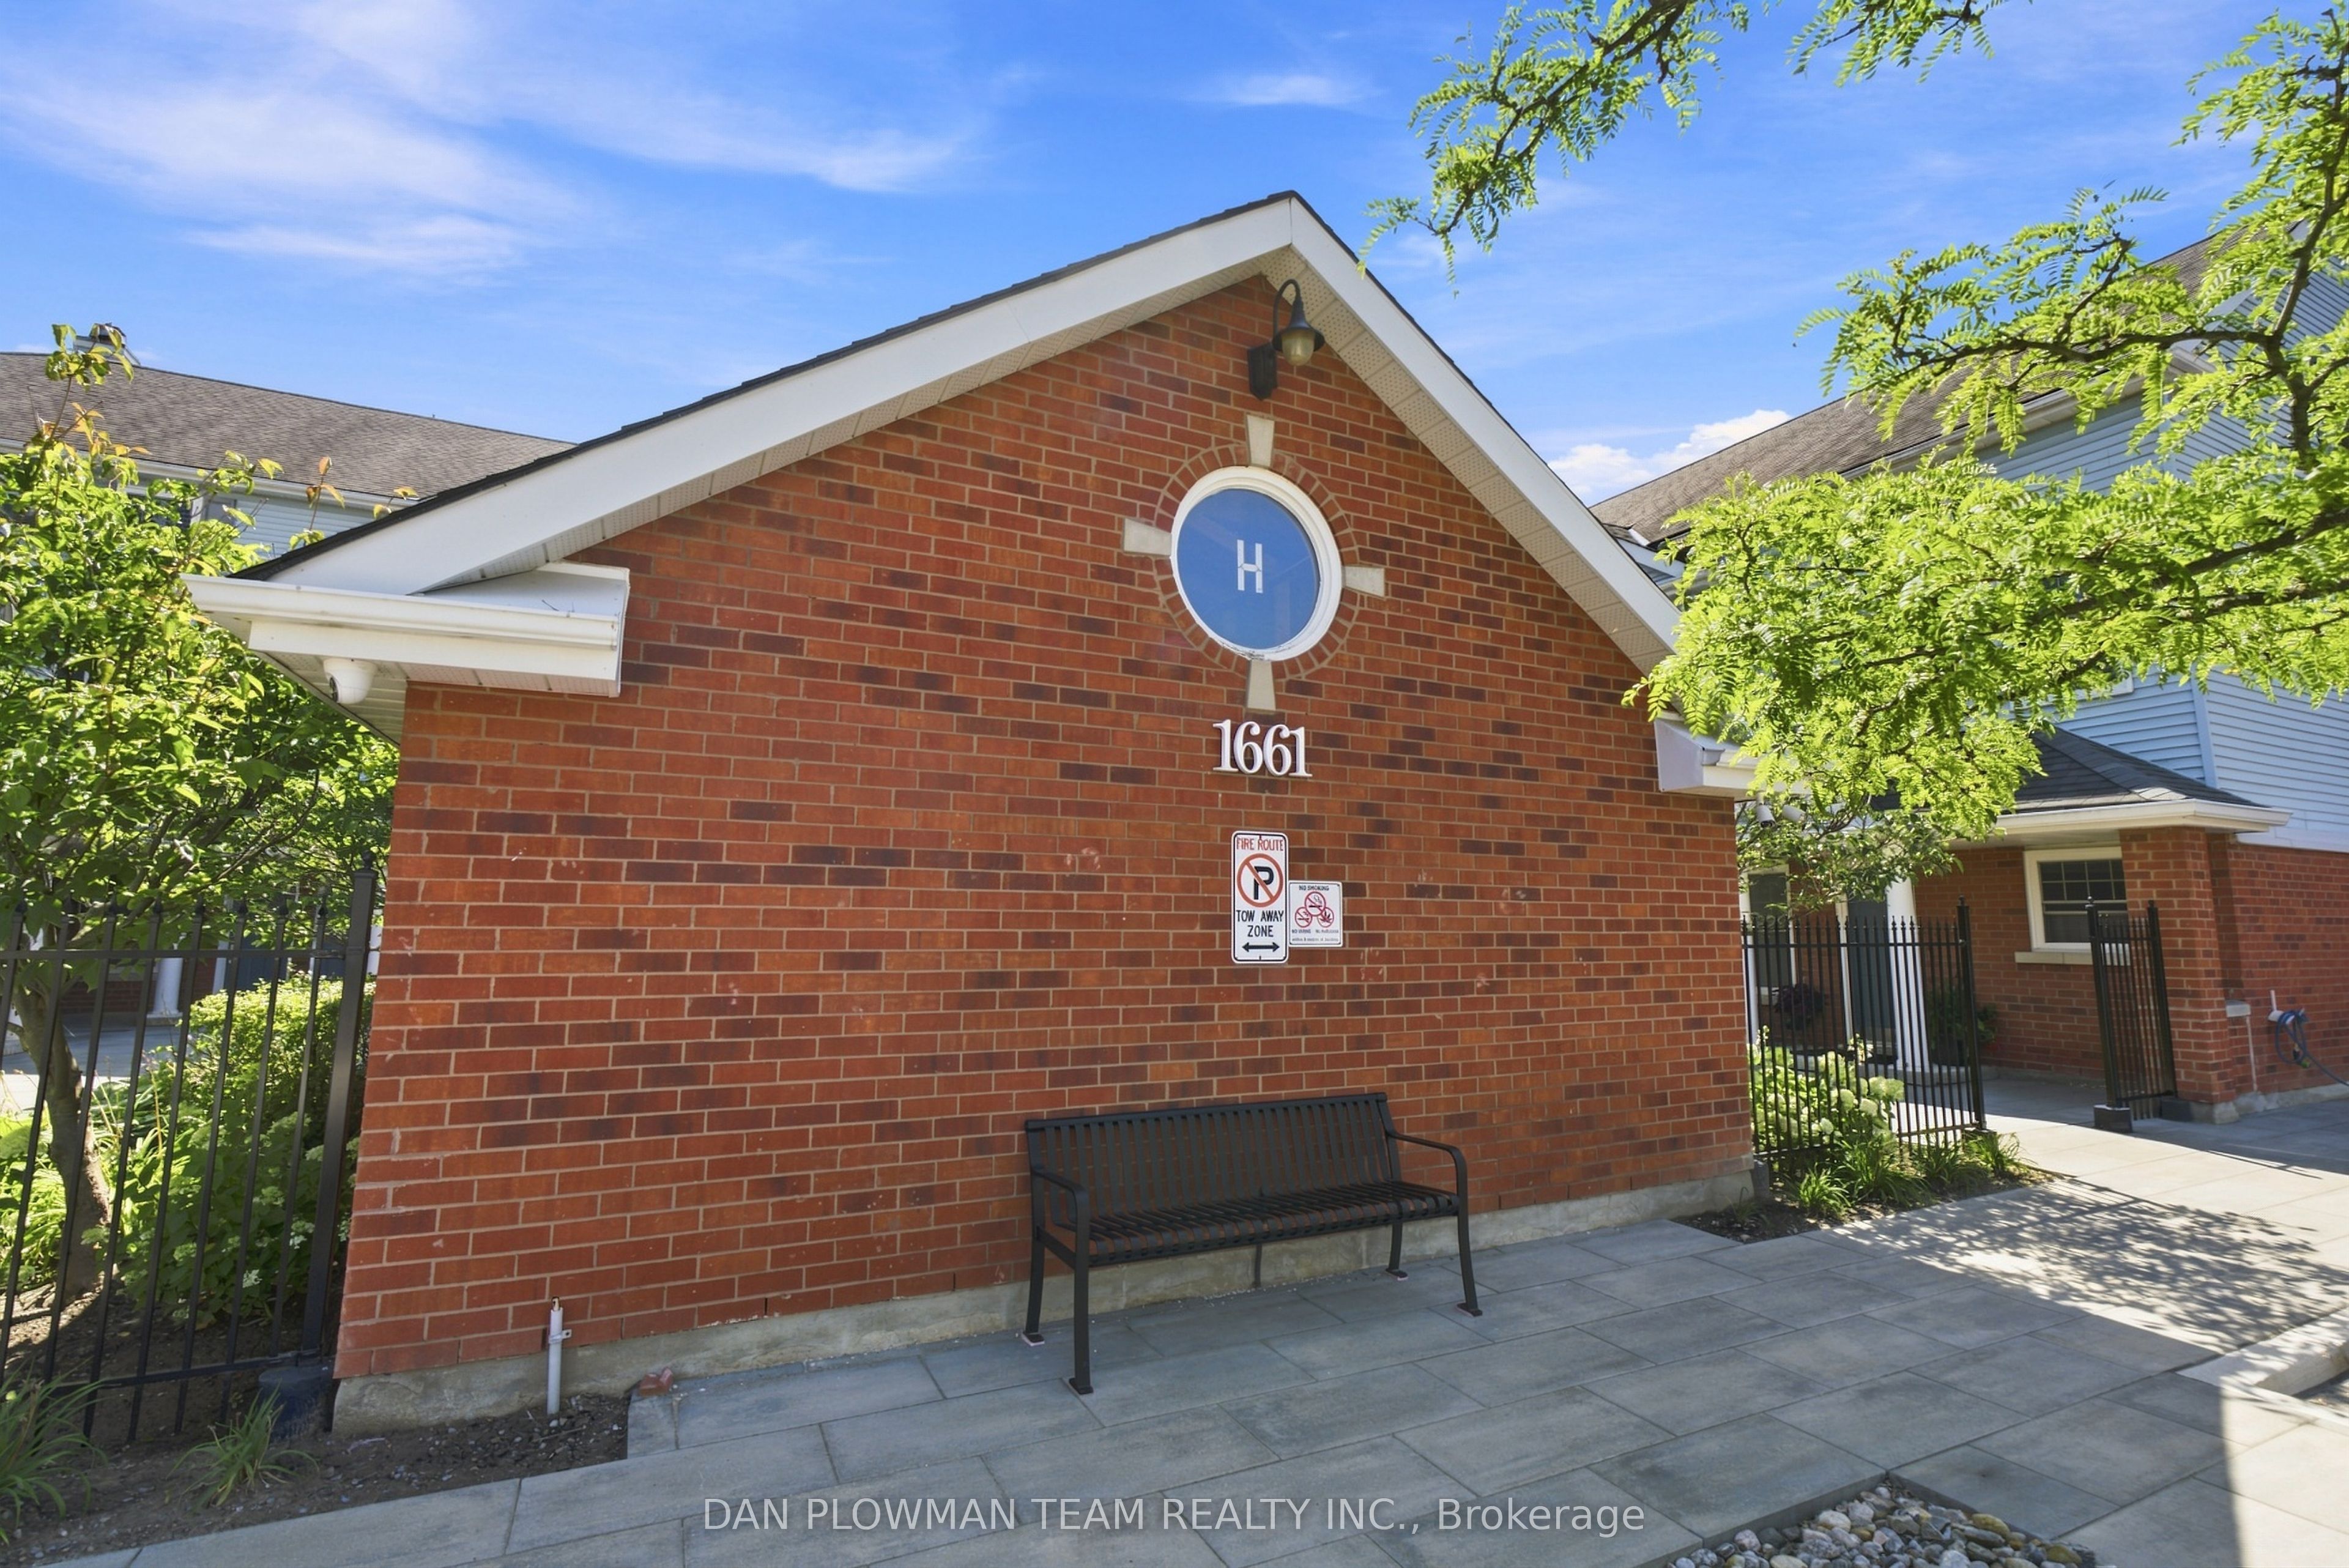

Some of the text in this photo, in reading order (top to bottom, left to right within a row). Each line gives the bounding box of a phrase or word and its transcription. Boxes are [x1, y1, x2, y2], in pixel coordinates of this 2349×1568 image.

[1237, 539, 1263, 593] H
[1212, 719, 1313, 778] 1661
[1236, 837, 1284, 852] FIRE ROUTE
[1236, 910, 1284, 923] TOW AWAY
[1247, 925, 1274, 937] ZONE
